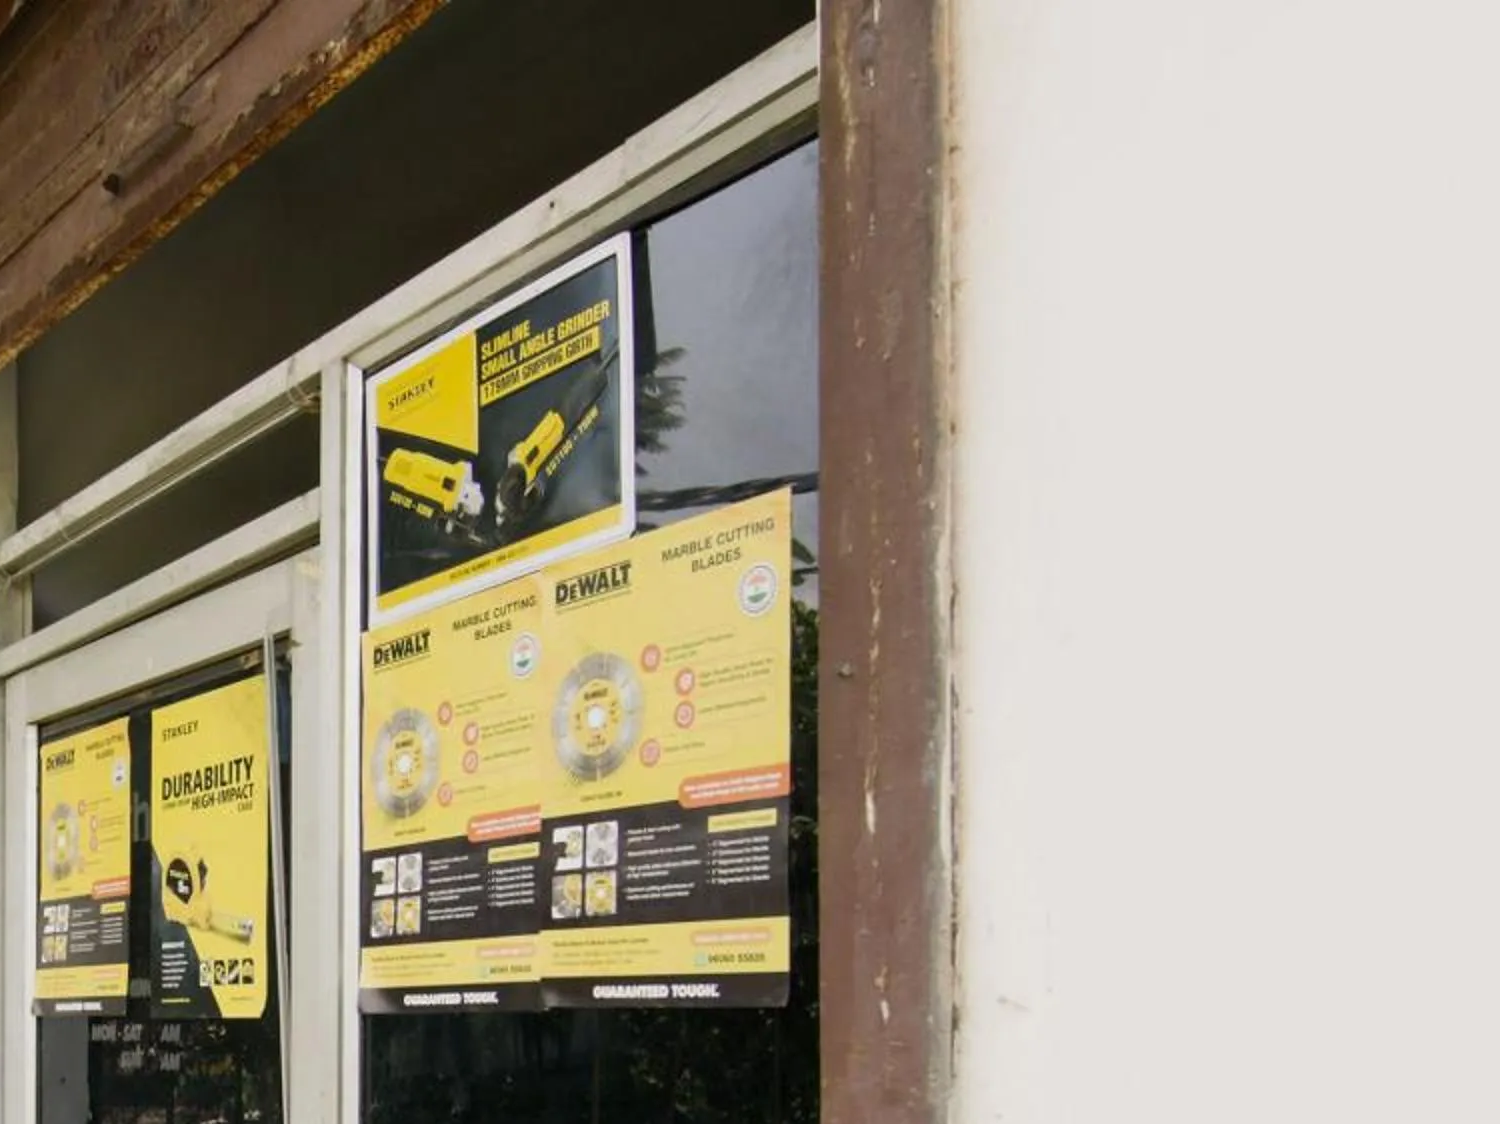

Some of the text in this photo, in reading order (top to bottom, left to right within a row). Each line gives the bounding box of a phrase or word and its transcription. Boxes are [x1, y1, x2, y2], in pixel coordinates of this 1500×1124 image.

[481, 299, 610, 380] SMALL ANGLE GRINDER
[661, 517, 775, 562] MARBLE CUTTING
[692, 547, 742, 572] BLADES
[452, 595, 536, 631] MARBLE CUTTING
[474, 621, 513, 641] BLADES
[162, 755, 254, 801] DURABILITY
[191, 783, 254, 810] HIGH-IMPACT
